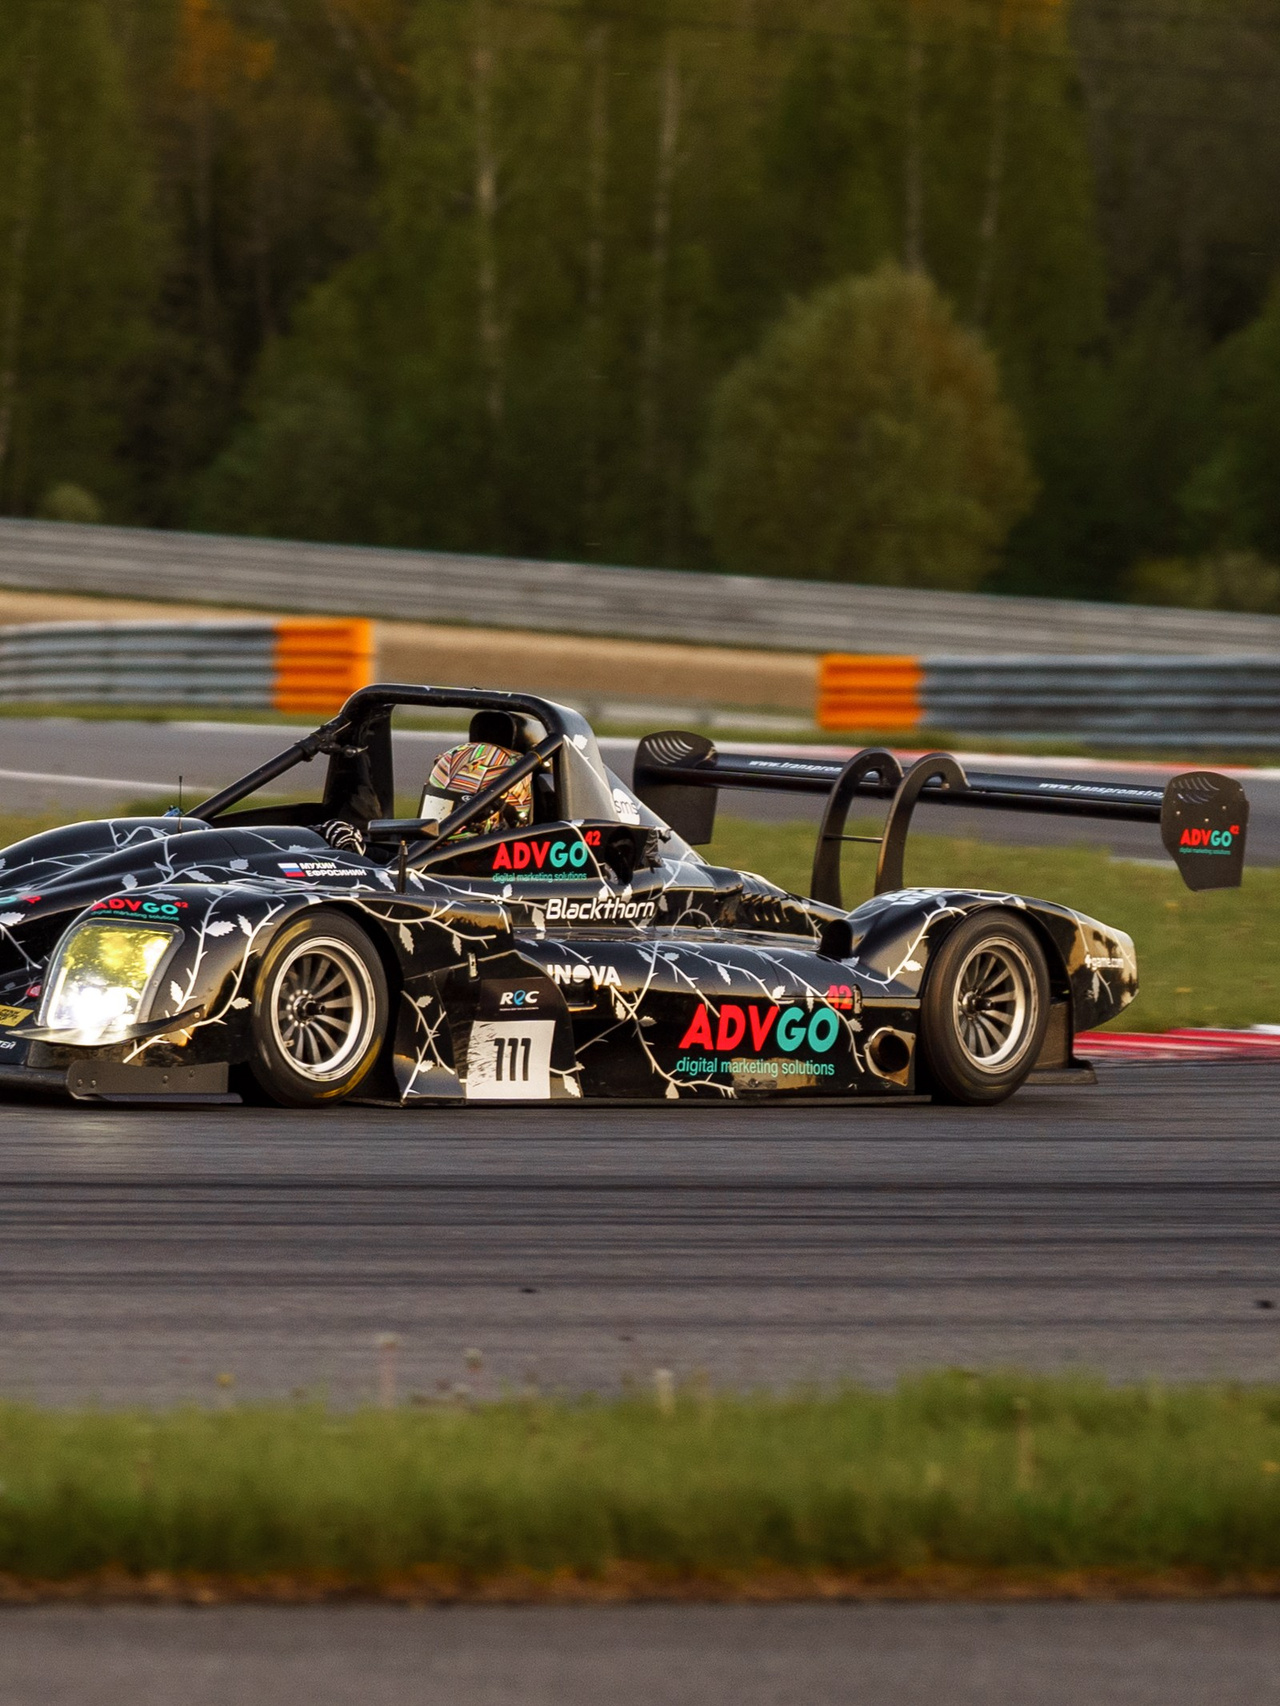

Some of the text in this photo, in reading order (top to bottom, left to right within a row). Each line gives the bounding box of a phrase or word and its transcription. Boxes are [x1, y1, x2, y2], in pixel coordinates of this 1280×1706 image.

[1179, 828, 1232, 847] ADVGO
[492, 830, 602, 870] ADVGO 42
[492, 871, 588, 884] digital marketing solutions
[90, 898, 179, 915] ADVGO
[546, 897, 655, 920] Blackthorn
[677, 985, 853, 1053] ADVGO 42
[493, 1037, 532, 1082] 111
[676, 1056, 835, 1078] digital marketing solutions
